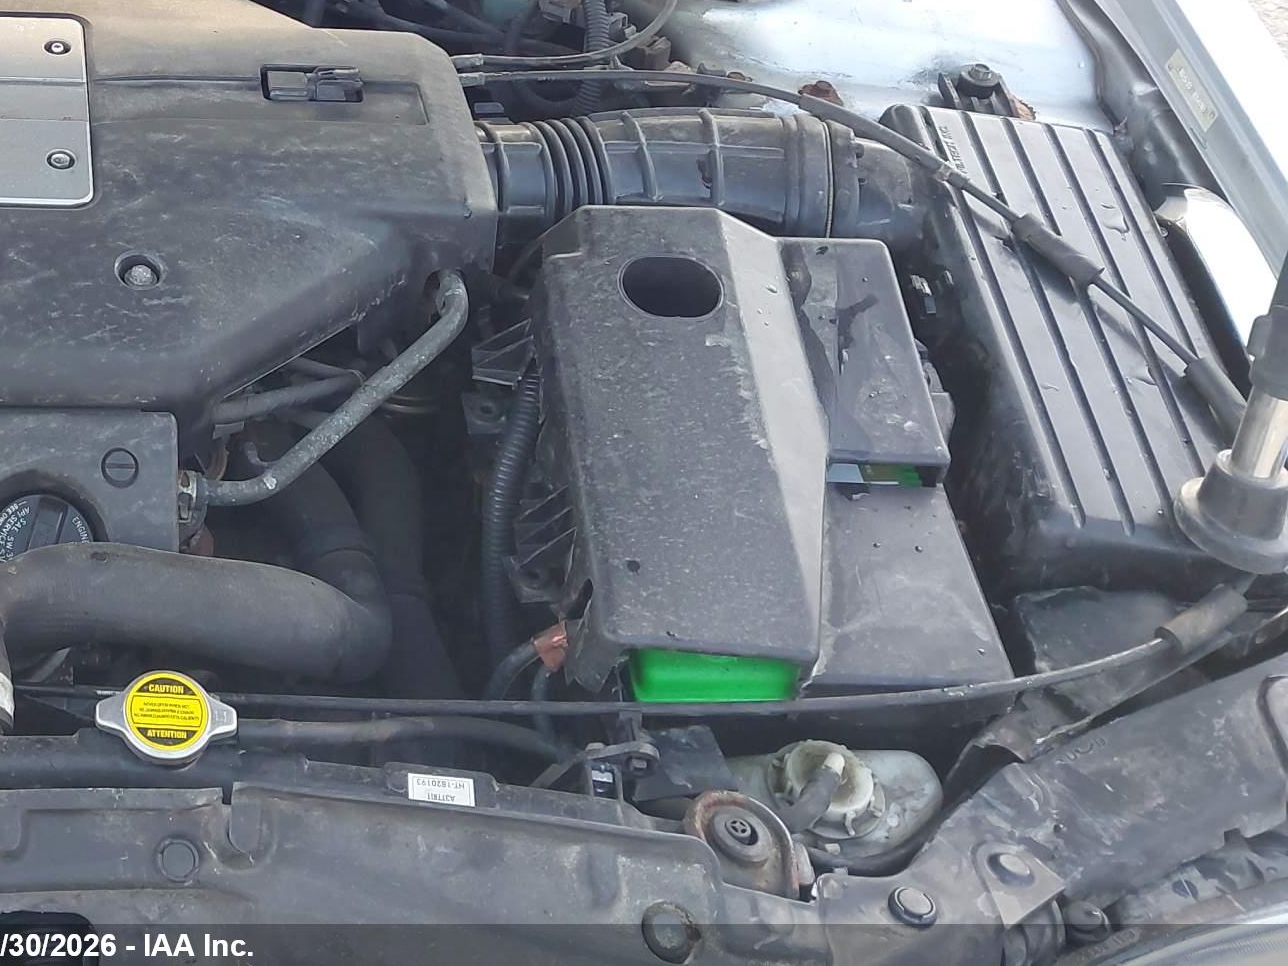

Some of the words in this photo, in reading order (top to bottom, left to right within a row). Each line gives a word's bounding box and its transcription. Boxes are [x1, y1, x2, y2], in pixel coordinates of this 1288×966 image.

[72, 516, 90, 544] ENGINE
[148, 684, 184, 694] CAUTION
[146, 729, 188, 740] ATTENTION
